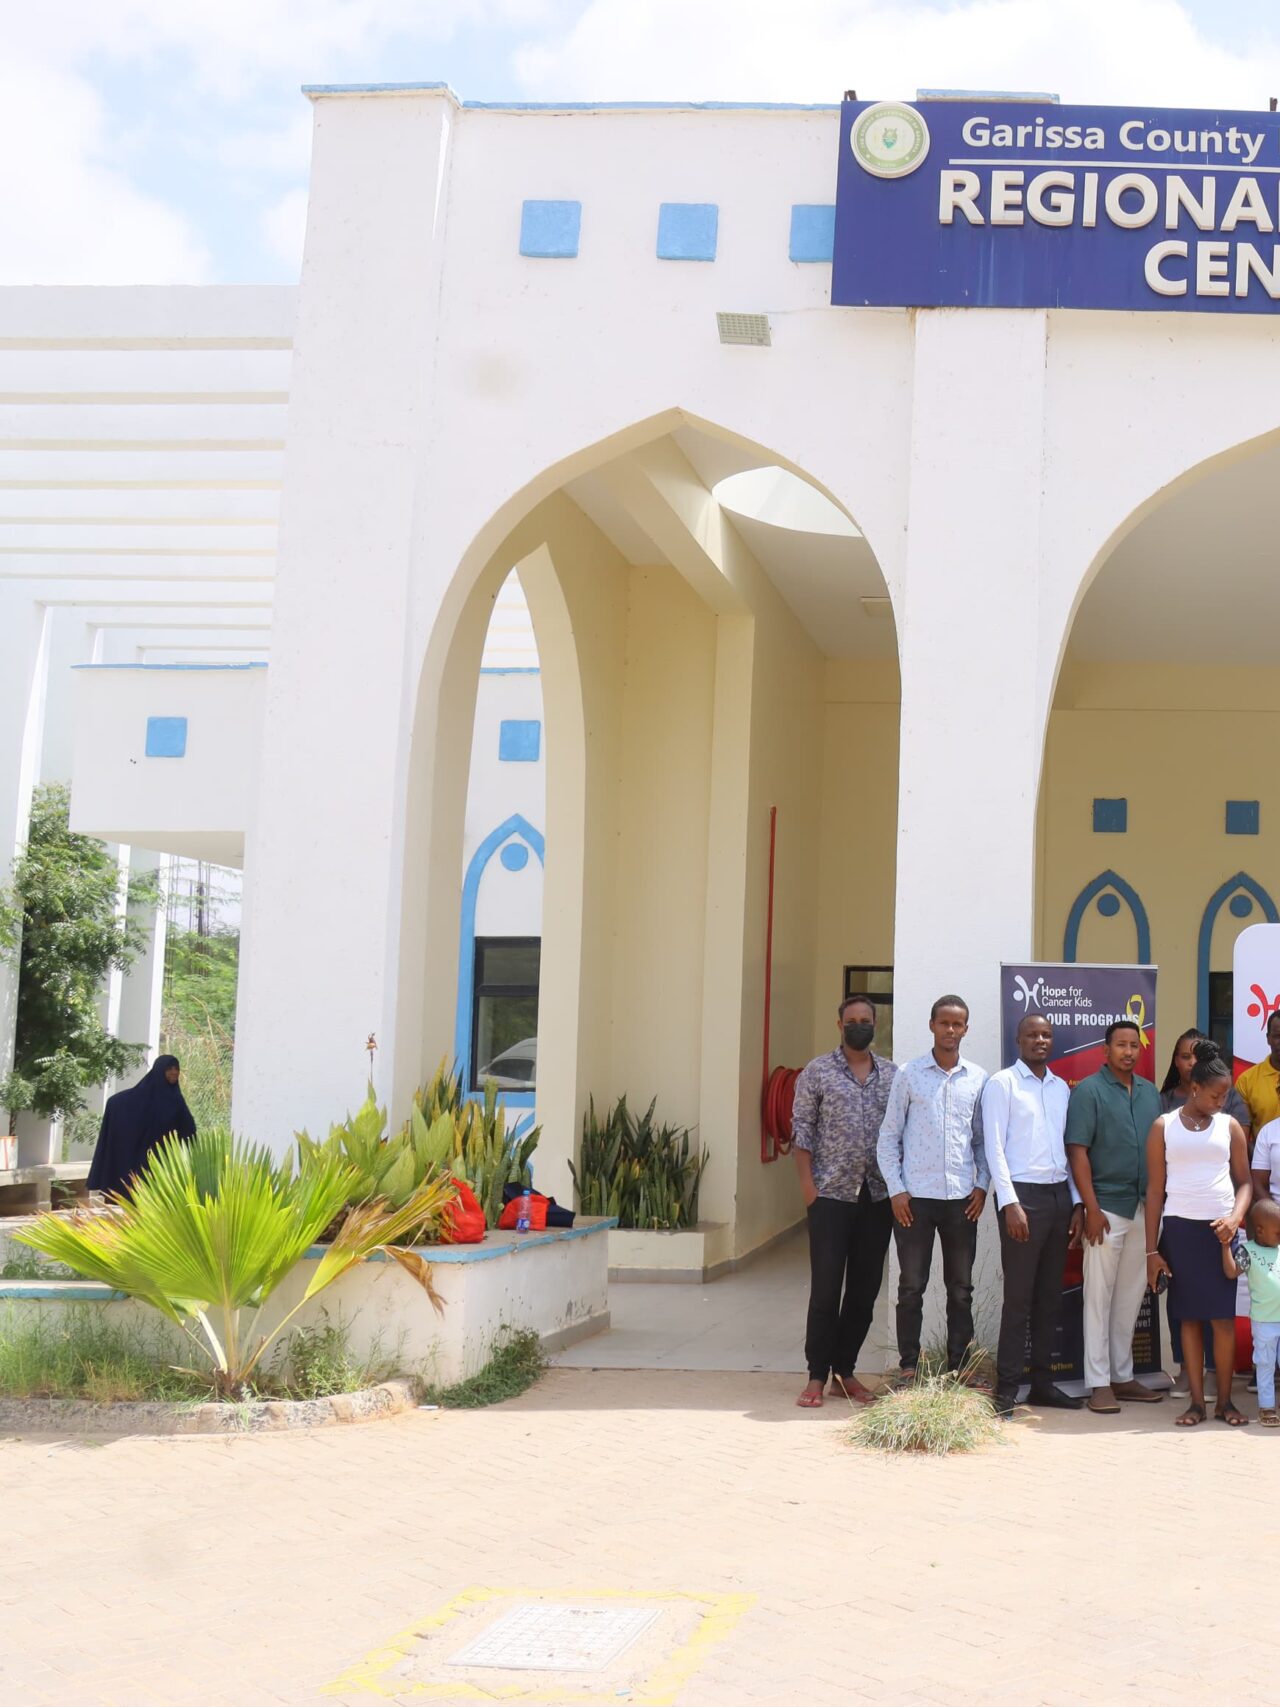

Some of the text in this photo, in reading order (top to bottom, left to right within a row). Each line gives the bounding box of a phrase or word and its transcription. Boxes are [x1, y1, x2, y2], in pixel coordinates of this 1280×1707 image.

[962, 116, 1105, 150] Garissa
[1119, 120, 1264, 163] County
[1041, 985, 1083, 998] Hope for
[1041, 996, 1092, 1007] Cancer Kids
[1047, 1013, 1071, 1026] OUR
